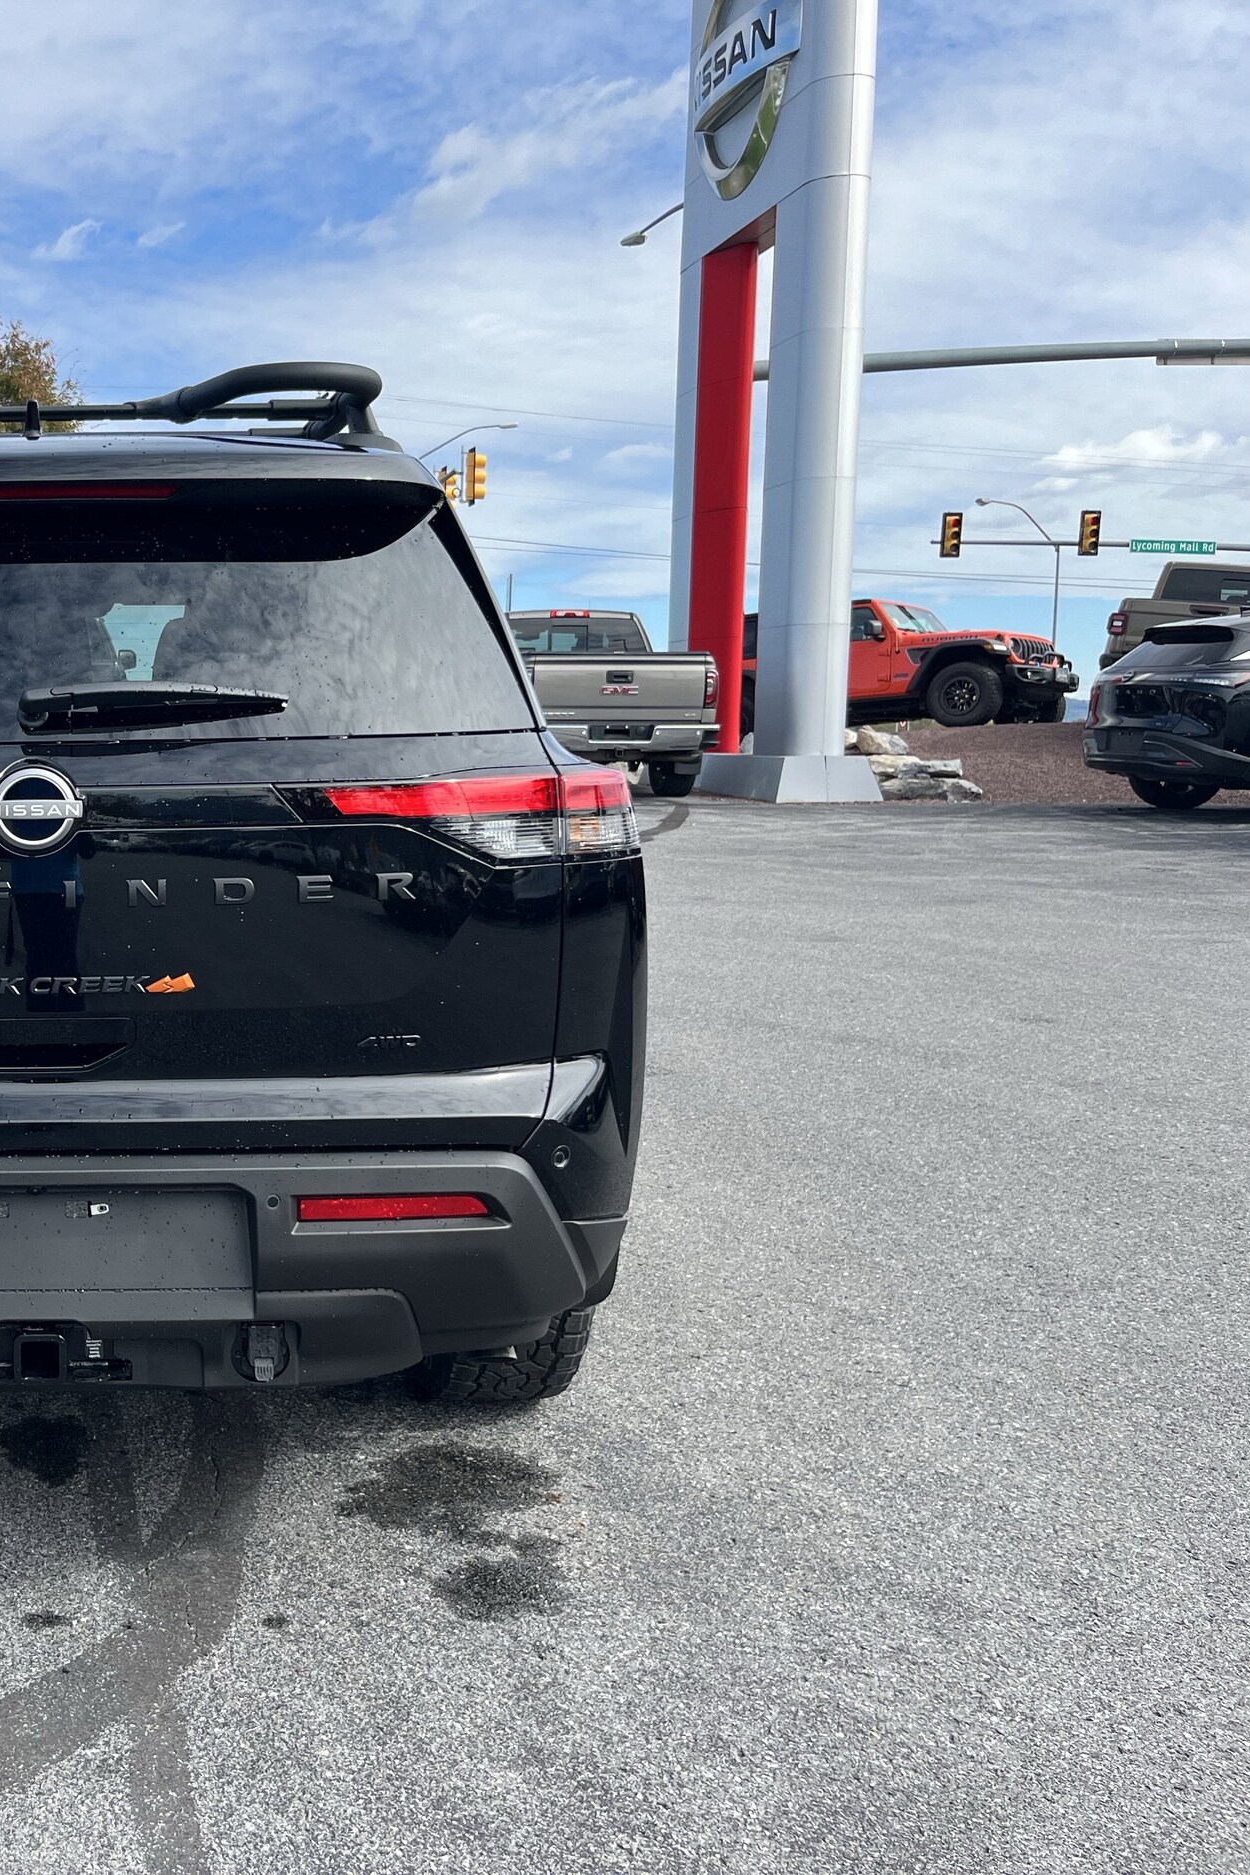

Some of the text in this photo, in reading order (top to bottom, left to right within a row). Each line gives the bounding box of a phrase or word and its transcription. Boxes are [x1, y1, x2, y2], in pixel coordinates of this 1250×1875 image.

[1132, 541, 1214, 553] Lycoming Mall Rd
[600, 685, 639, 696] GMC
[29, 974, 151, 996] CREEK
